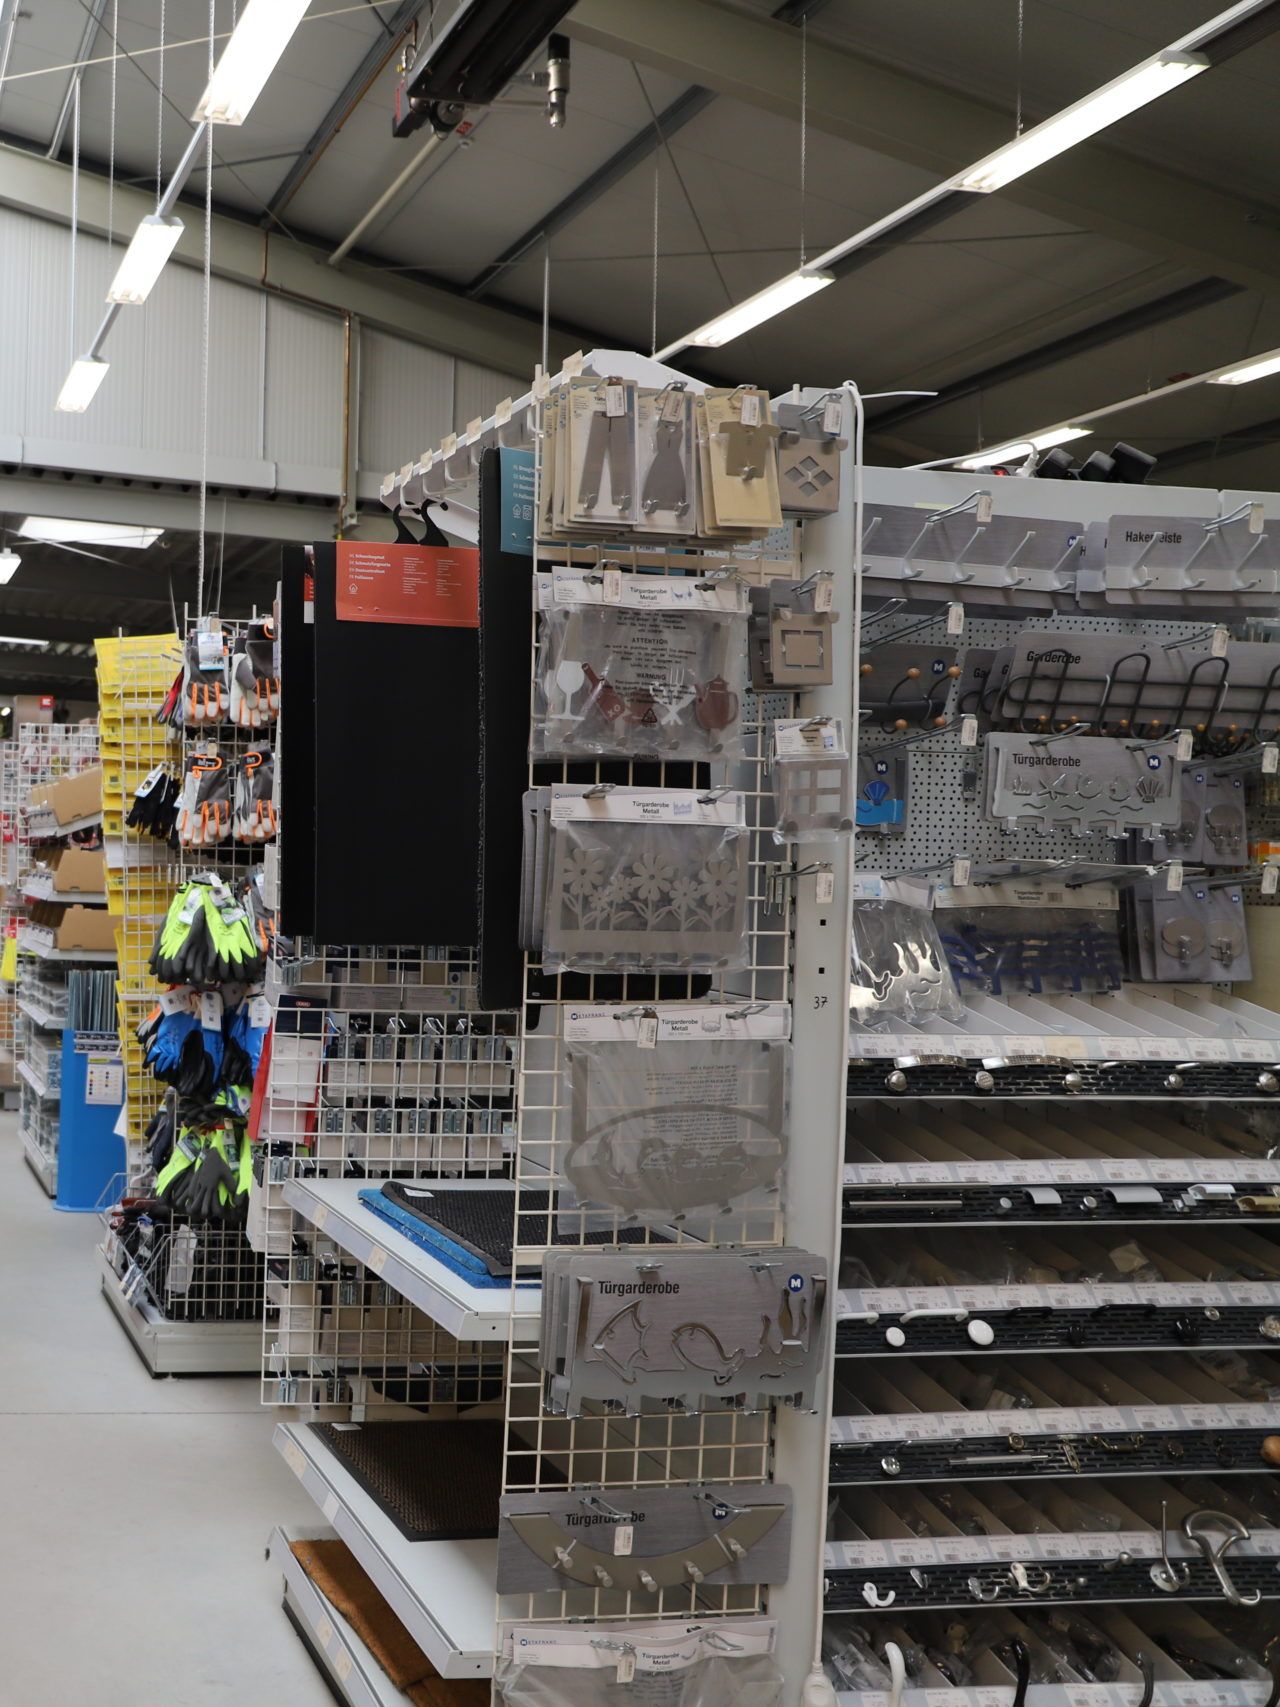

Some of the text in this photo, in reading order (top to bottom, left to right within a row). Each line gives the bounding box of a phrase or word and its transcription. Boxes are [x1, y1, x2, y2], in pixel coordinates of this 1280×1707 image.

[630, 586, 668, 596] Türgarderobe
[631, 637, 669, 645] ATTENTION
[1026, 650, 1081, 665] Garderobe
[1012, 752, 1081, 768] Türgarderobe
[632, 800, 670, 809] Türgarderobe
[813, 996, 828, 1009] 37
[661, 1018, 699, 1026] Türgarderobe
[598, 1279, 680, 1298] Türgarderobe
[642, 1652, 680, 1661] Türgarderobe
[652, 1658, 671, 1666] Metall
